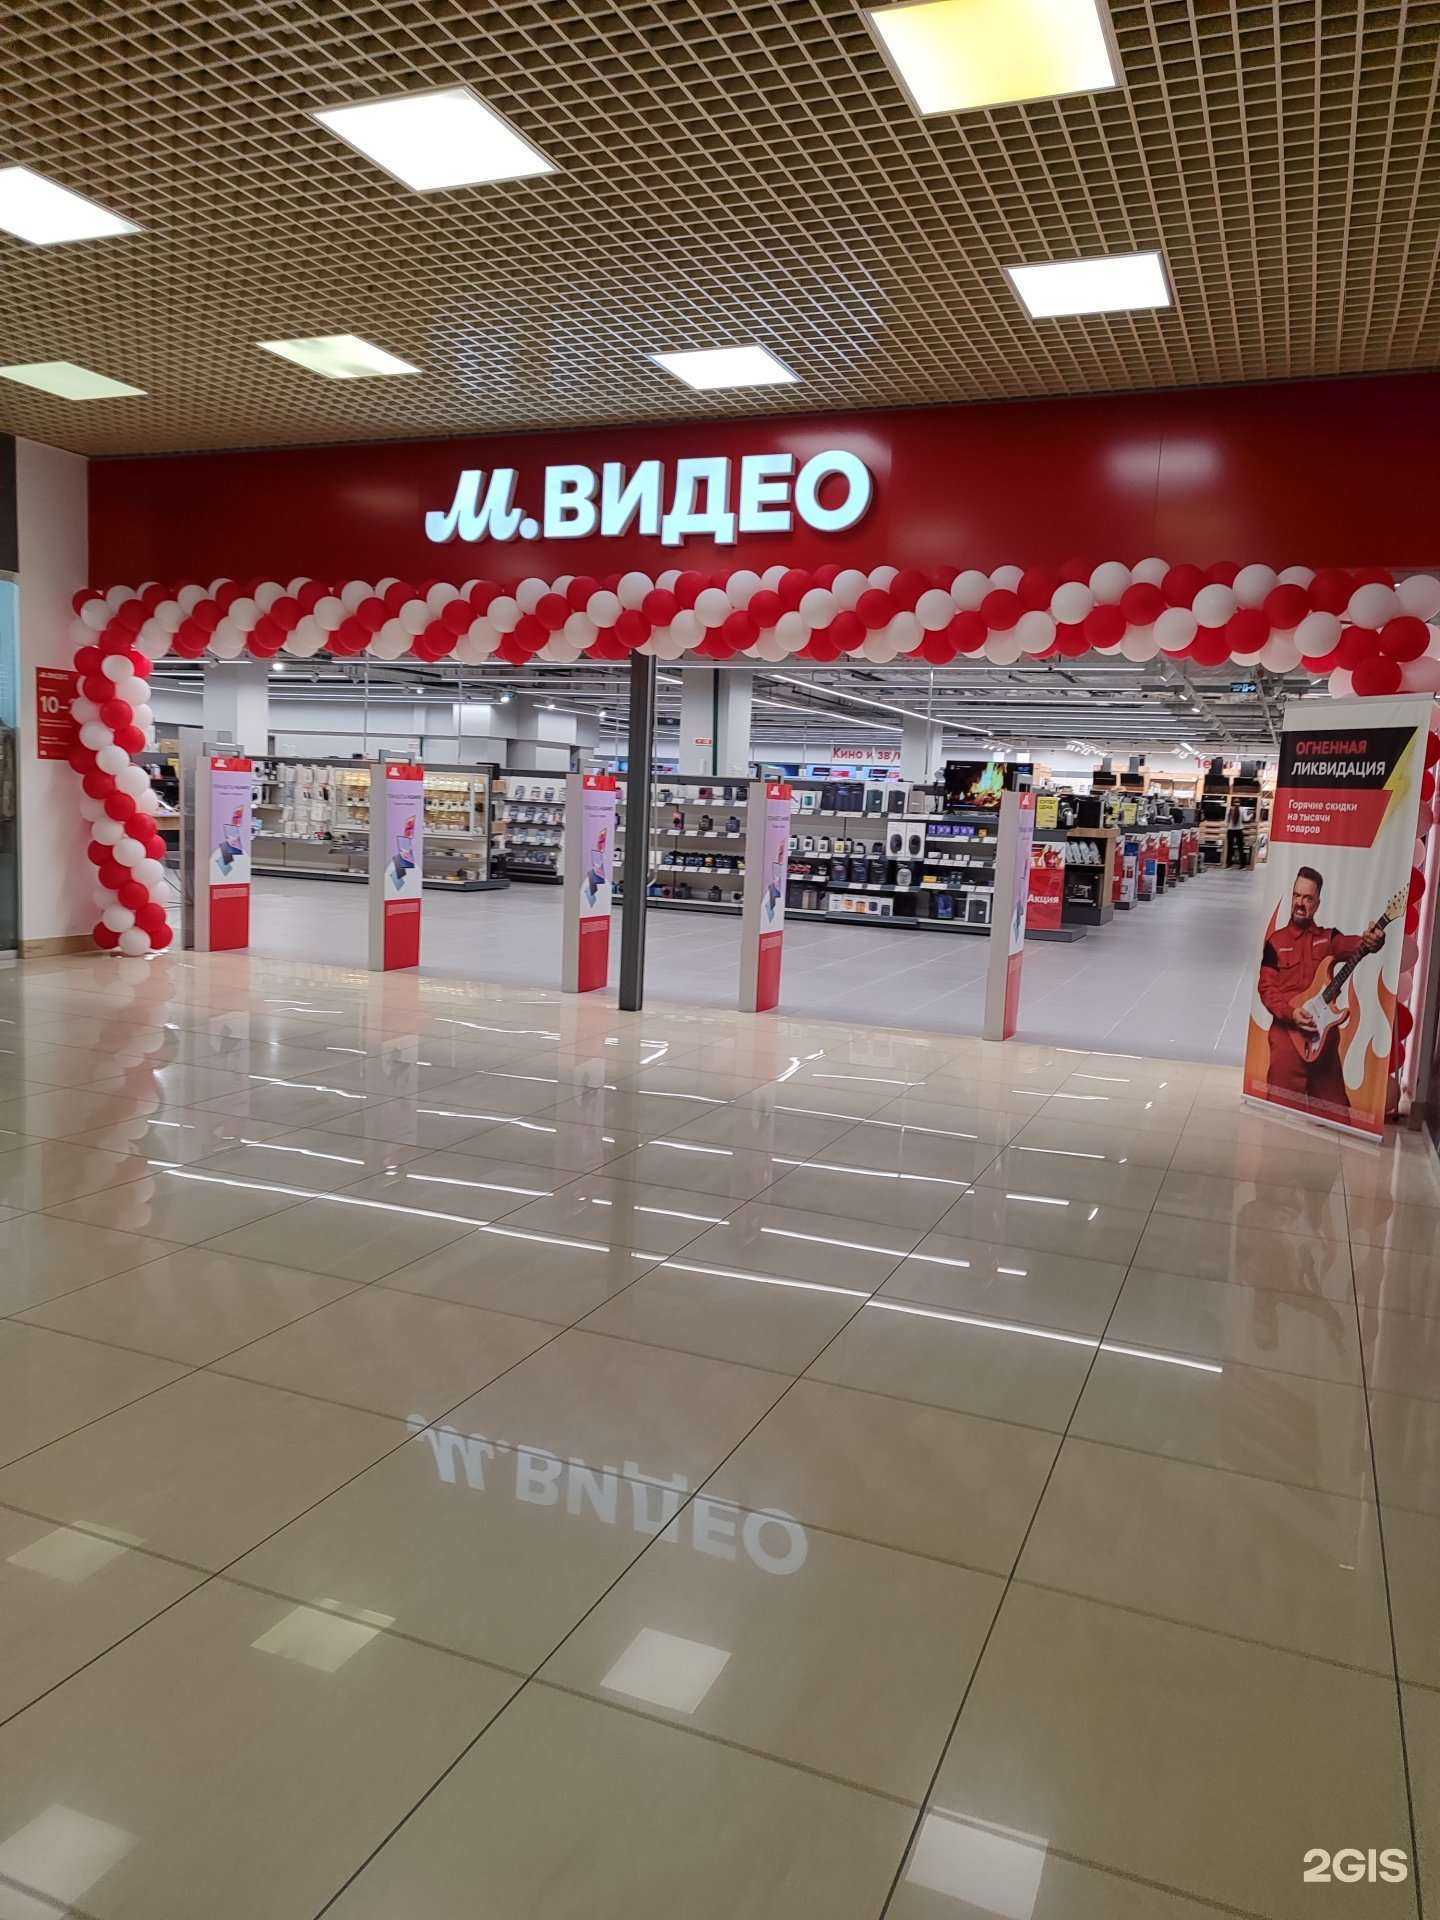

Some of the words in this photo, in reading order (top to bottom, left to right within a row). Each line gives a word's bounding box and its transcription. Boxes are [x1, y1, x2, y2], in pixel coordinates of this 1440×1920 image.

[832, 746, 863, 759] Кино
[1295, 740, 1368, 755] ОГНЕННАЯ
[1291, 761, 1386, 778] ЛИКВИДАЦИЯ
[1288, 799, 1324, 811] Горячие
[1325, 803, 1358, 812] скидки
[1299, 815, 1331, 823] тысячи
[1286, 823, 1321, 834] товаров
[1026, 894, 1060, 905] Акция
